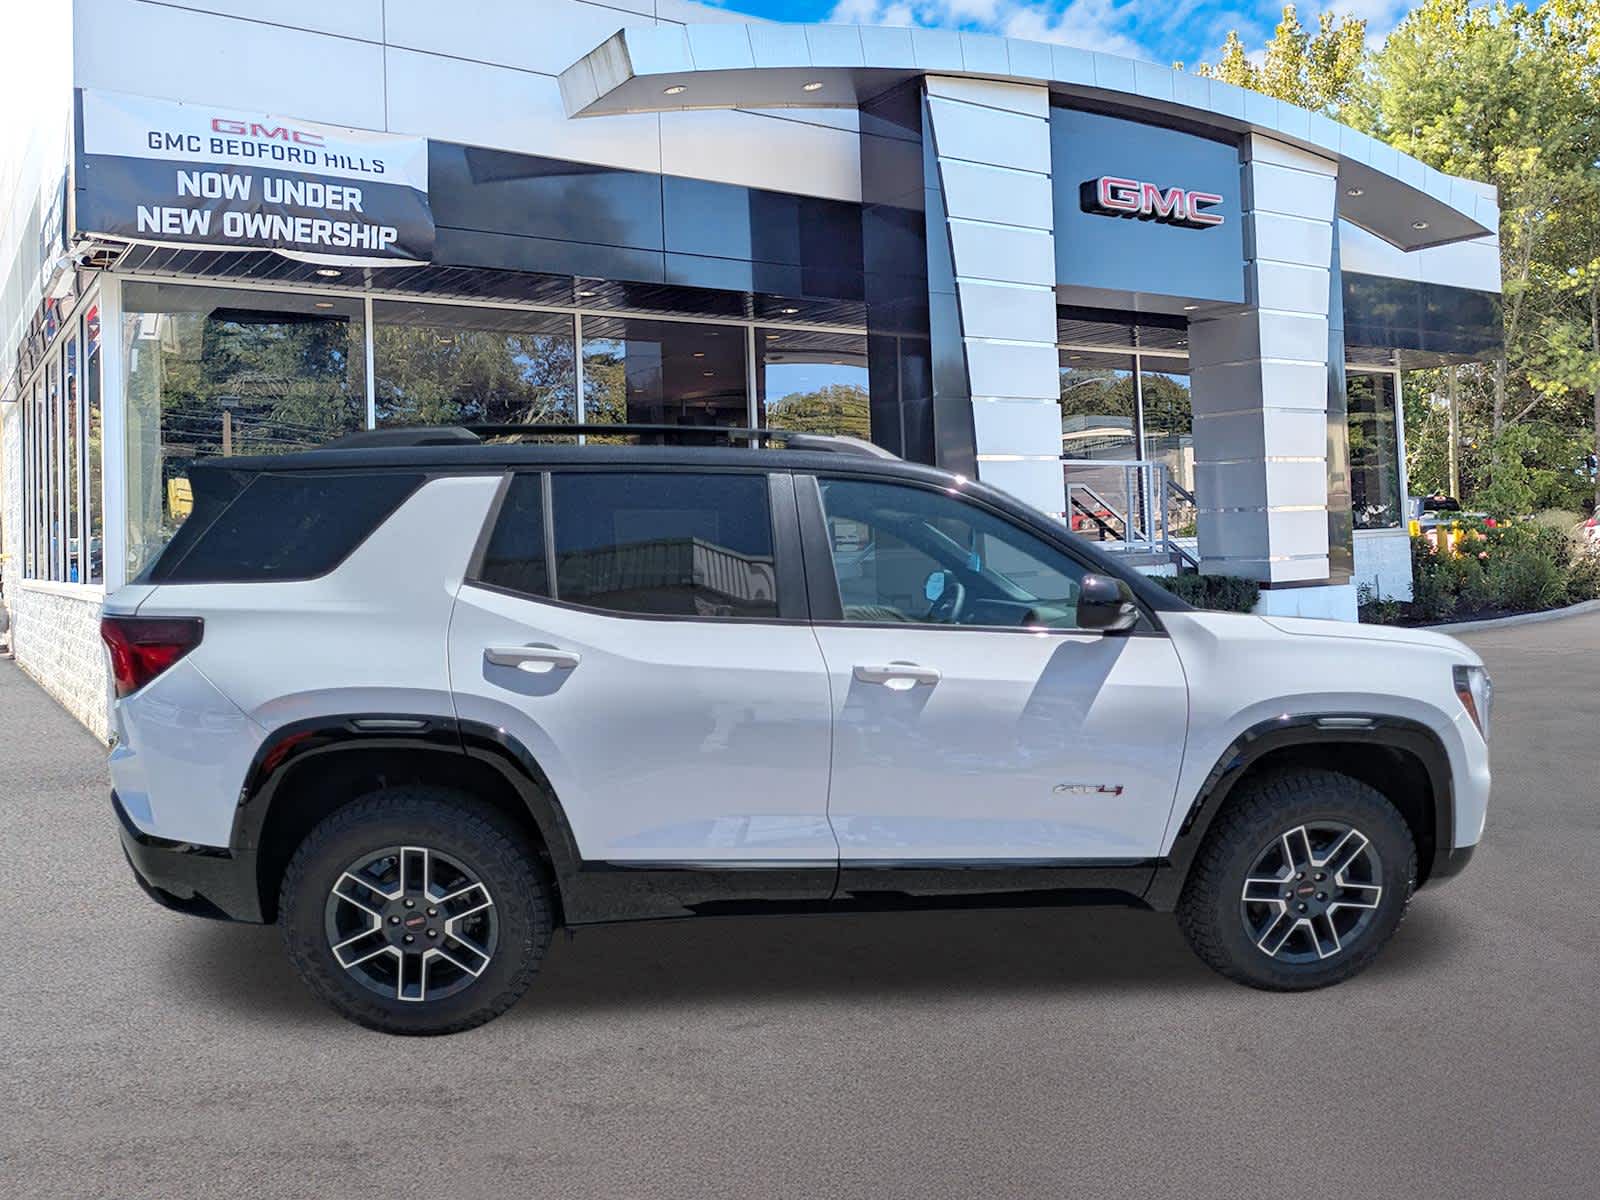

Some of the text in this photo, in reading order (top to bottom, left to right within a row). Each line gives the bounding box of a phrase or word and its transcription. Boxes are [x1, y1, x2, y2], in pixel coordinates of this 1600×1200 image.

[148, 131, 386, 174] GMC BEDFORD HILLS
[212, 118, 325, 148] GMC
[177, 170, 363, 212] NOW UNDER
[1098, 175, 1225, 225] GMC
[137, 206, 398, 250] NEW OWNERSHIP
